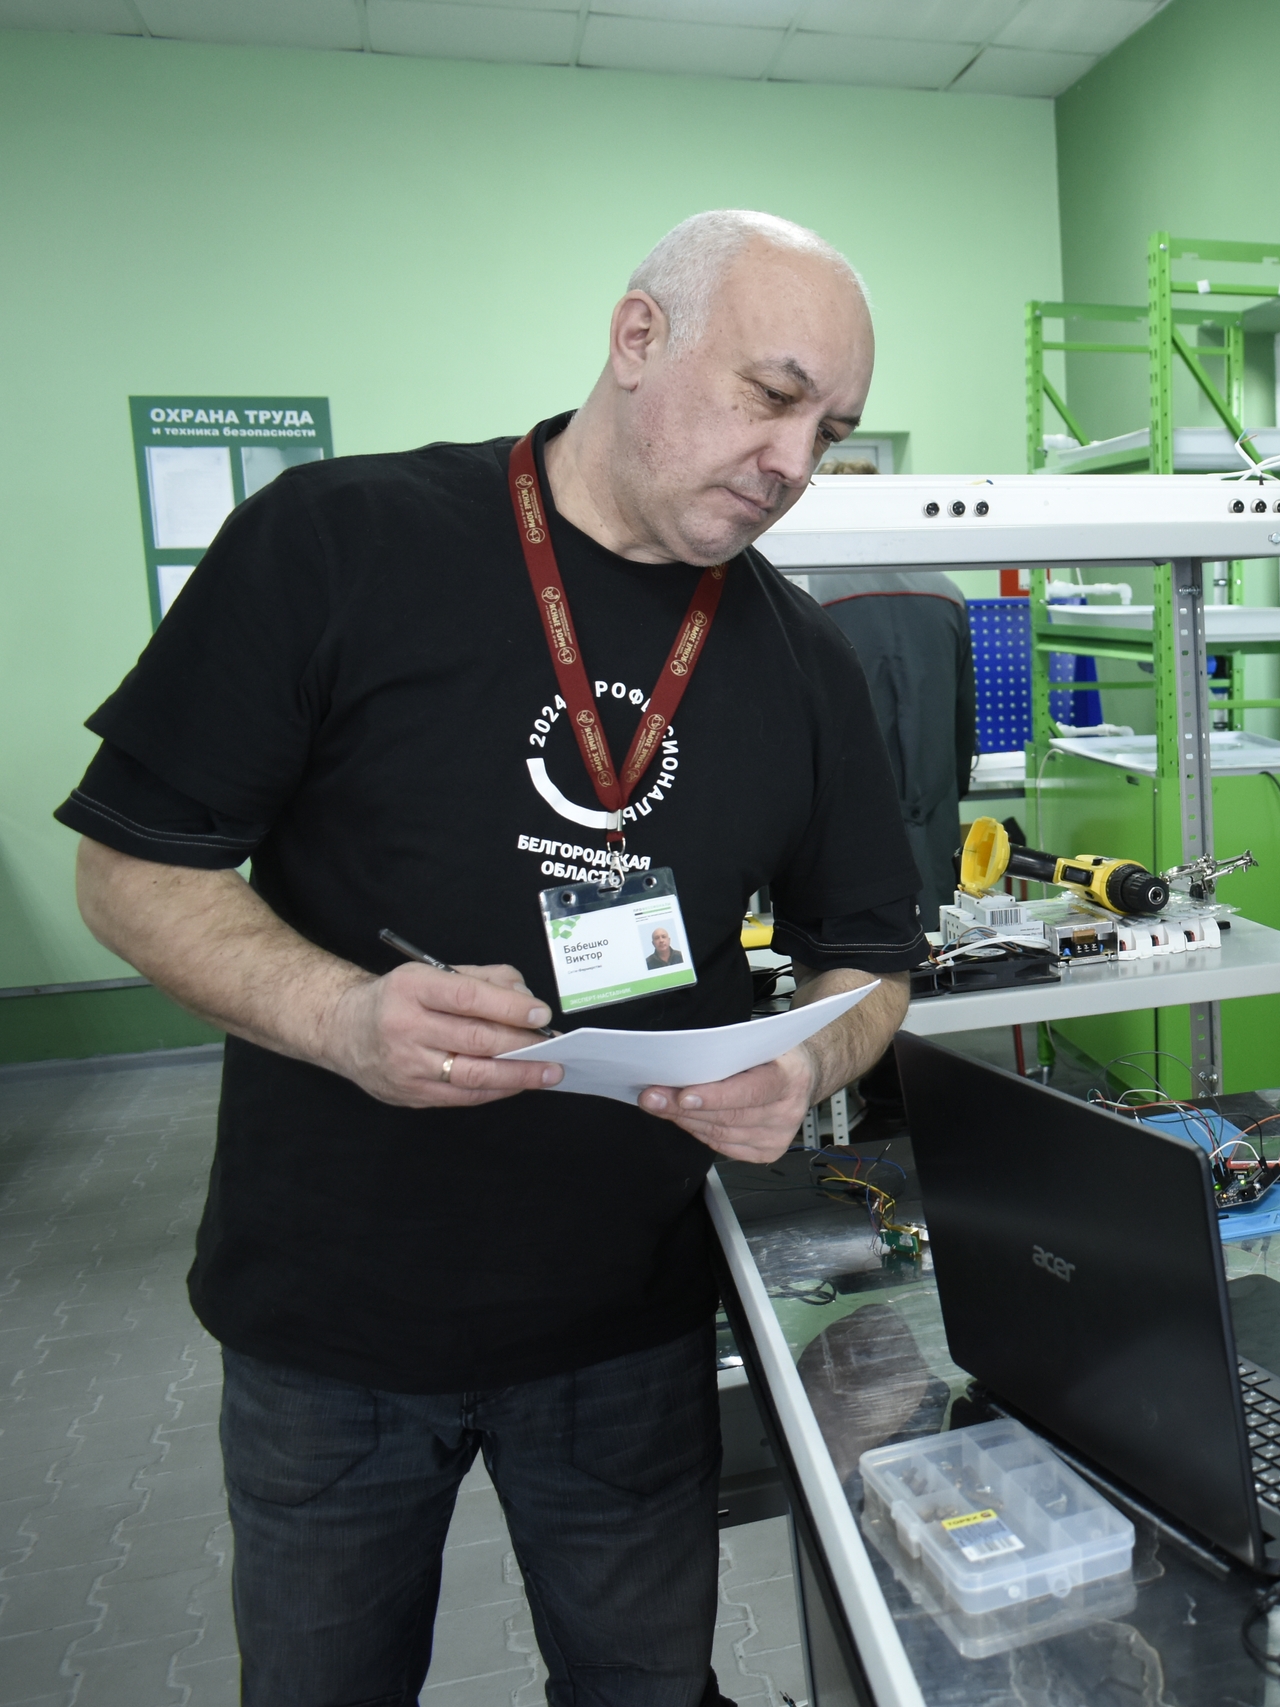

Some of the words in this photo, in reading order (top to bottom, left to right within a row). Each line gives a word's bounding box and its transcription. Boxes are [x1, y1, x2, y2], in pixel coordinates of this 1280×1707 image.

[150, 407, 240, 424] ОХРАНА
[244, 409, 314, 427] ТРУДА
[152, 427, 161, 435] и
[164, 427, 219, 437] техника
[222, 426, 316, 438] безопасности
[525, 511, 535, 528] ЗОРИ
[548, 602, 560, 626] ЯСНЫЕ
[554, 628, 566, 648] ЗОРИ
[680, 641, 693, 662] ЯСНЫЕ
[688, 624, 700, 642] ЗОРИ
[530, 694, 567, 747] 2024
[644, 728, 657, 747] ЗОРИ
[584, 726, 596, 751] ЯСНЫЕ
[591, 751, 603, 771] ЗОРИ
[563, 938, 609, 954] Бабешко
[565, 951, 603, 965] Виктор
[1032, 1244, 1076, 1283] acer
